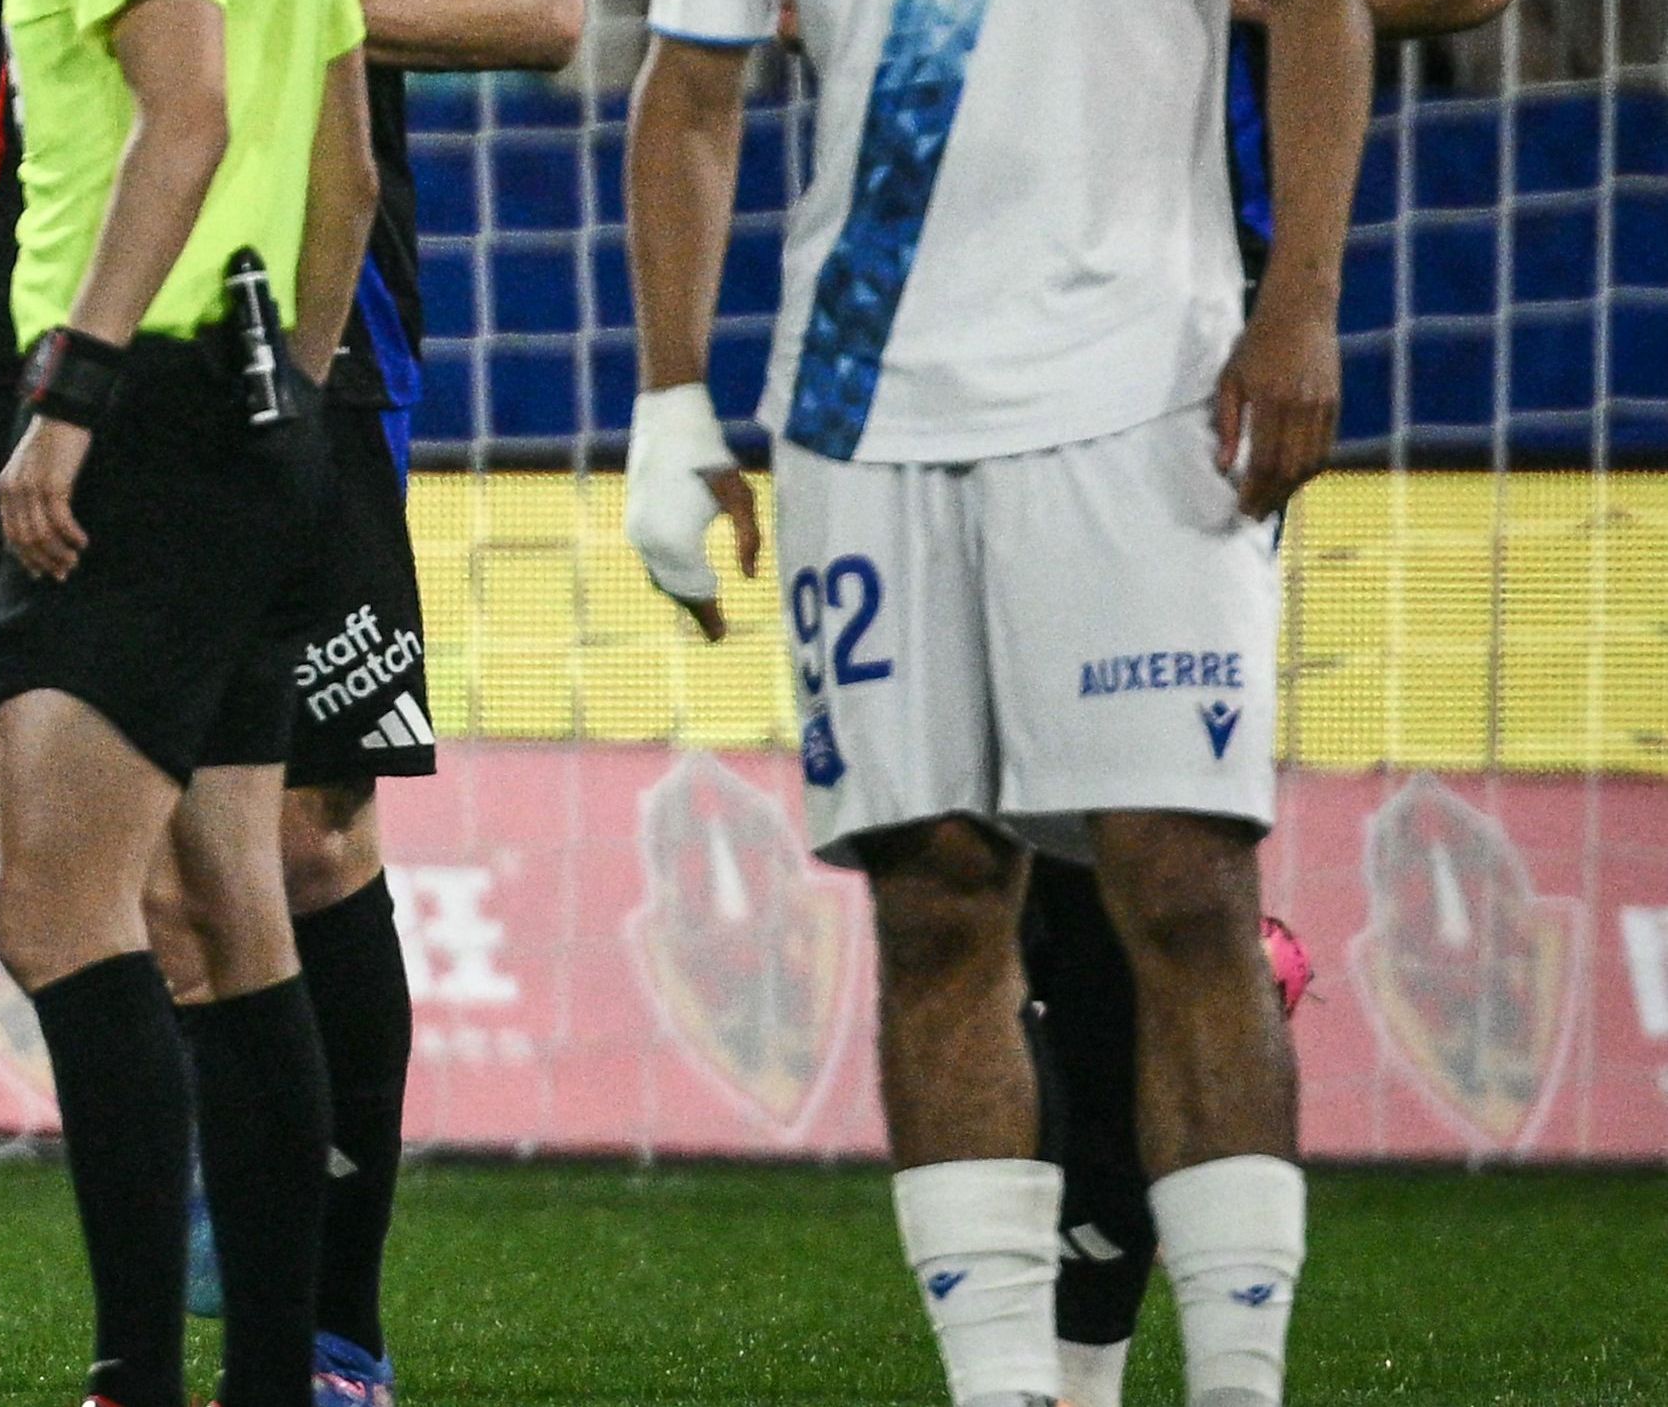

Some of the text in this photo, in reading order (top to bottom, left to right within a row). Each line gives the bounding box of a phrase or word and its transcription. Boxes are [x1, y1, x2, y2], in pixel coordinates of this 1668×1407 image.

[792, 553, 895, 695] 92
[306, 627, 423, 722] match
[1078, 651, 1244, 698] AUXERRE
